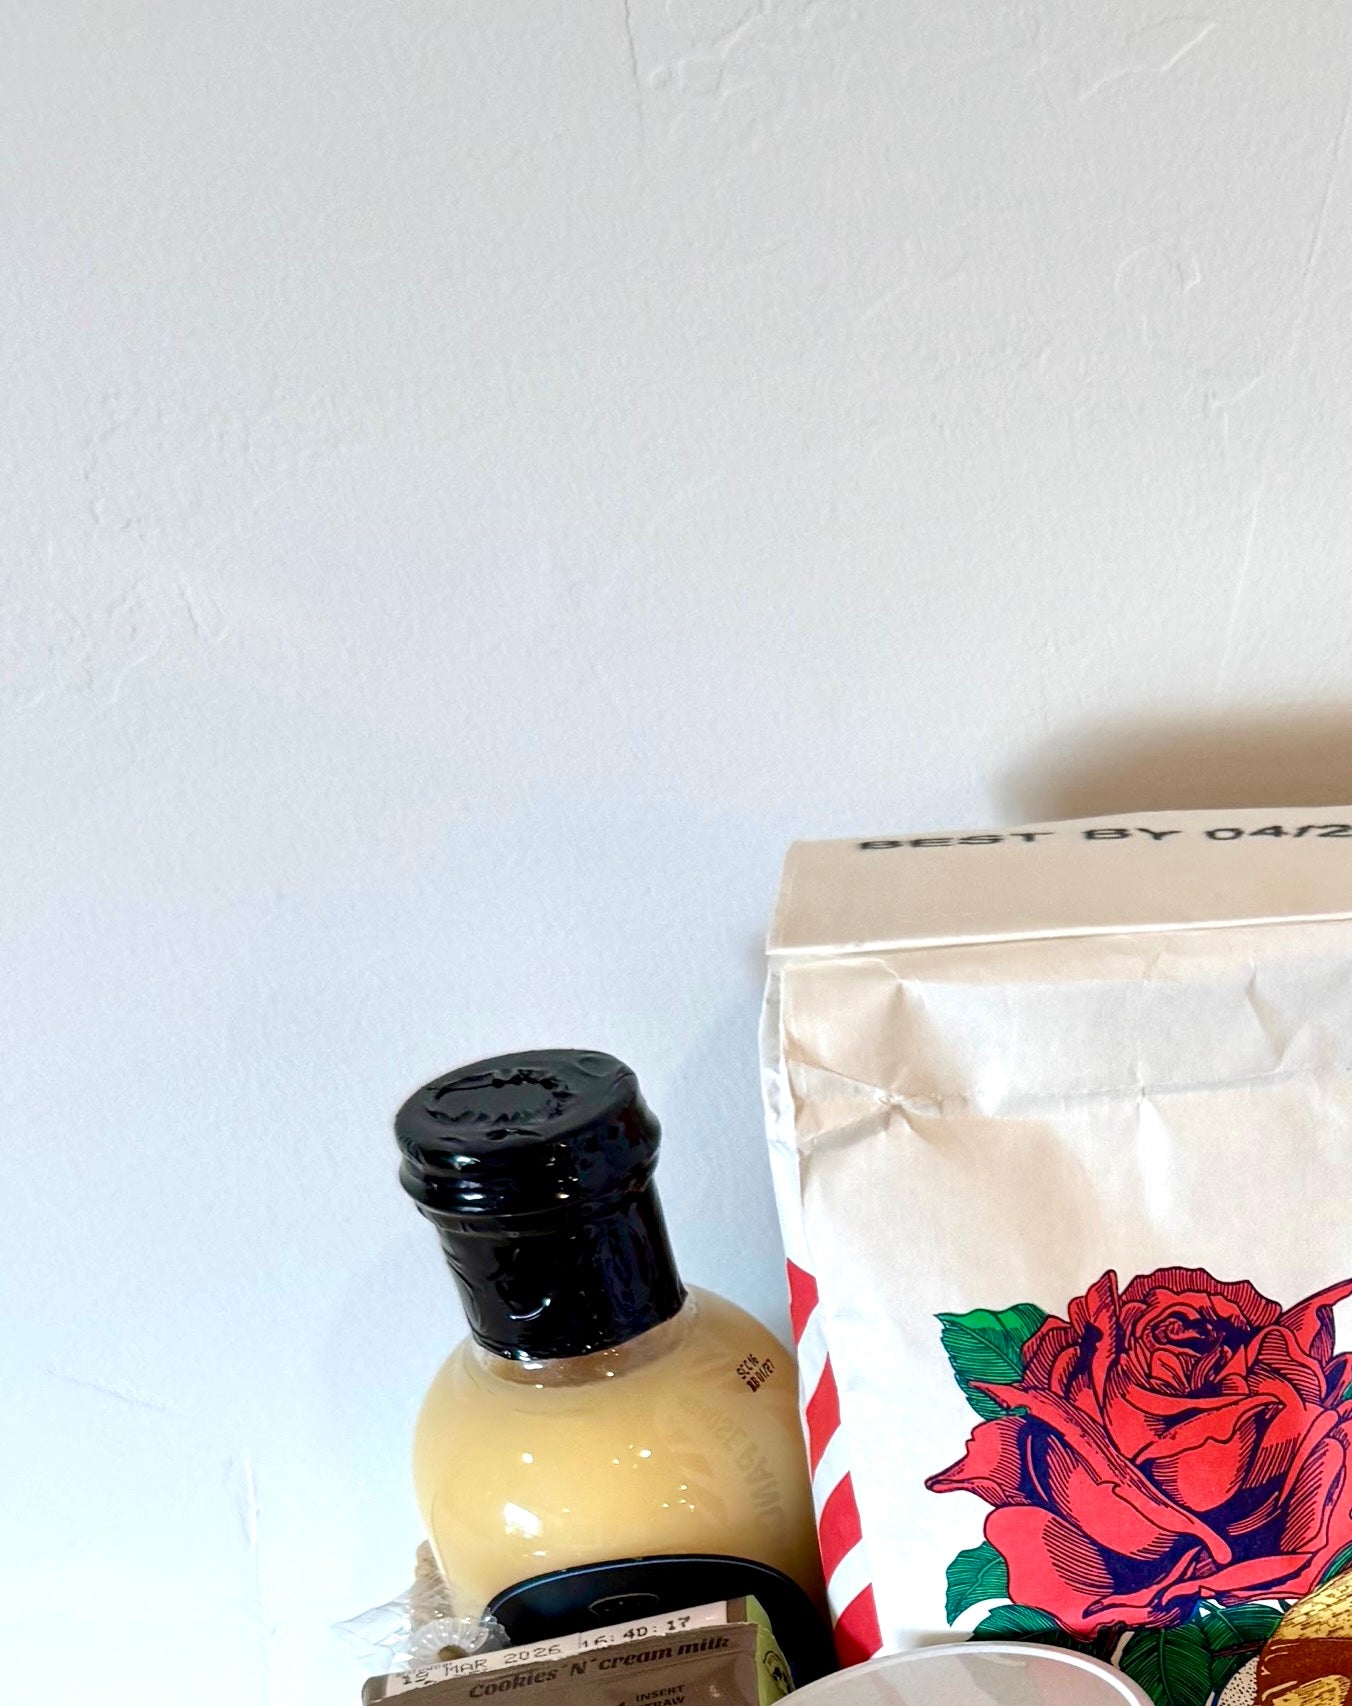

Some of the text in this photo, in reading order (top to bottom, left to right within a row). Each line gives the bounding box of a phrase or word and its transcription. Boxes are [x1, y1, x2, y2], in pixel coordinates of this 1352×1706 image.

[859, 831, 1054, 850] BEST
[1083, 827, 1184, 842] BY
[444, 1658, 489, 1677] MAR
[503, 1644, 562, 1664] 2026
[469, 1666, 558, 1698] Cookies
[599, 1645, 674, 1671] cream
[676, 1635, 730, 1656] milk
[635, 1683, 686, 1701] INSERT
